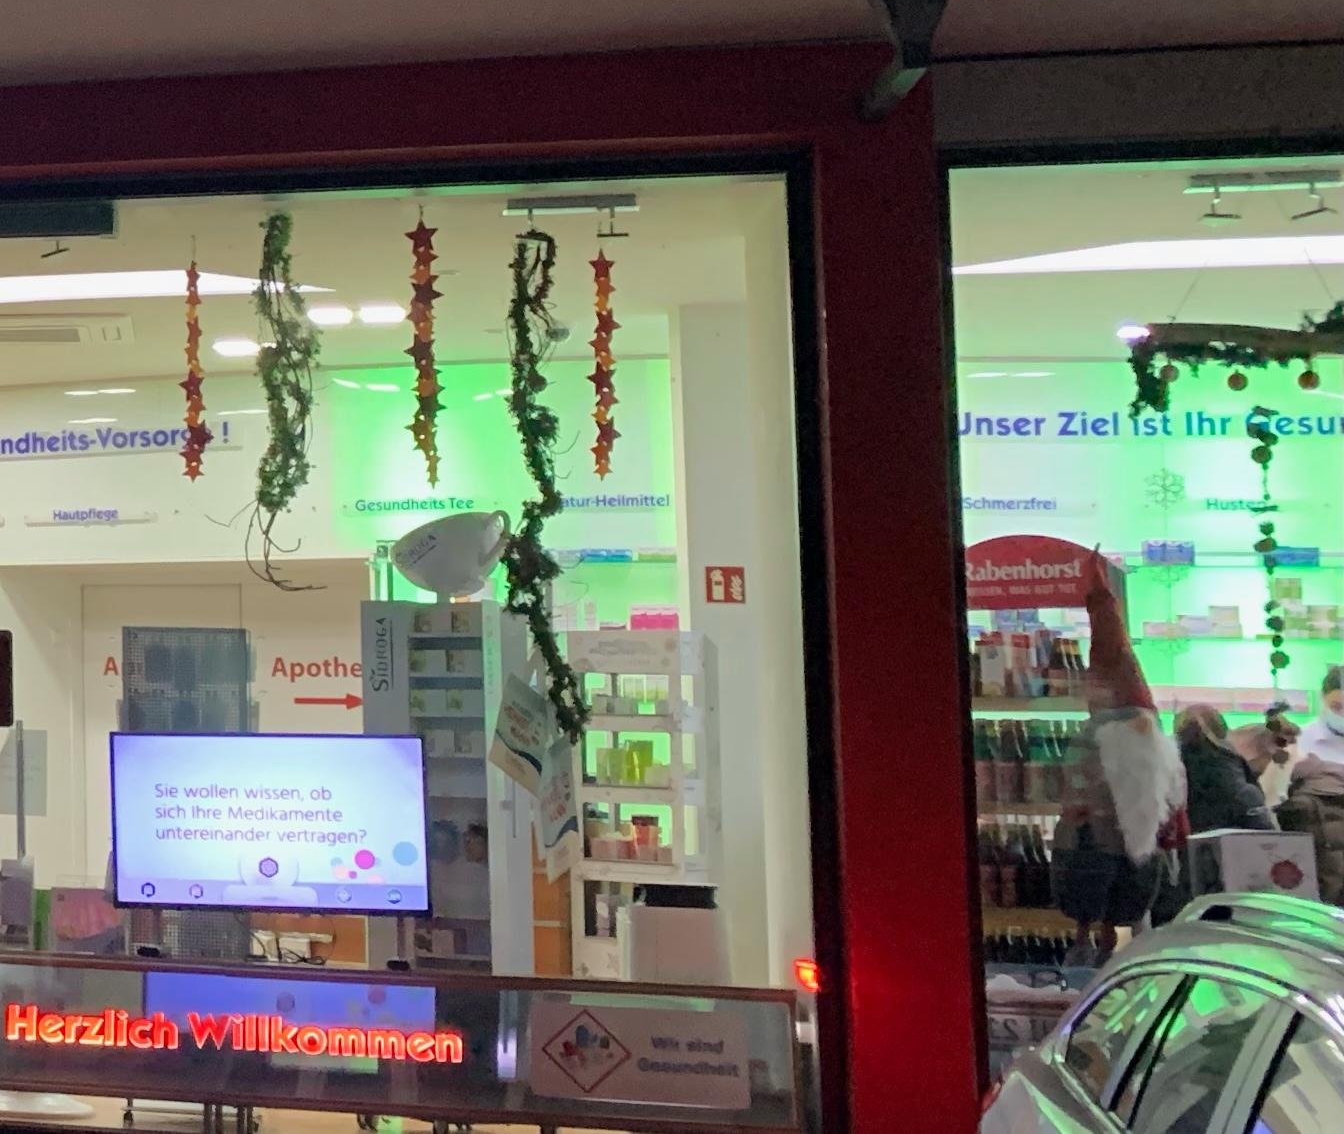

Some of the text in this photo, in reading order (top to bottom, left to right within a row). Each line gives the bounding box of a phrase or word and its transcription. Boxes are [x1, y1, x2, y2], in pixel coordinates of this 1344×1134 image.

[1057, 411, 1120, 437] Ziel
[1133, 412, 1173, 437] ist
[1185, 411, 1232, 437] Ihr
[355, 497, 475, 512] Gesundheits Tee
[560, 494, 670, 508] atur-Heilmittel
[963, 496, 1057, 512] Schmerzfrei
[53, 508, 119, 522] Hautpflege
[154, 783, 332, 803] Sie wollen wissen, ob
[155, 804, 343, 822] sich Ihre Medikamente
[155, 826, 367, 846] untereinander vertragen?
[5, 1003, 464, 1065] Herzlich Willkommen
